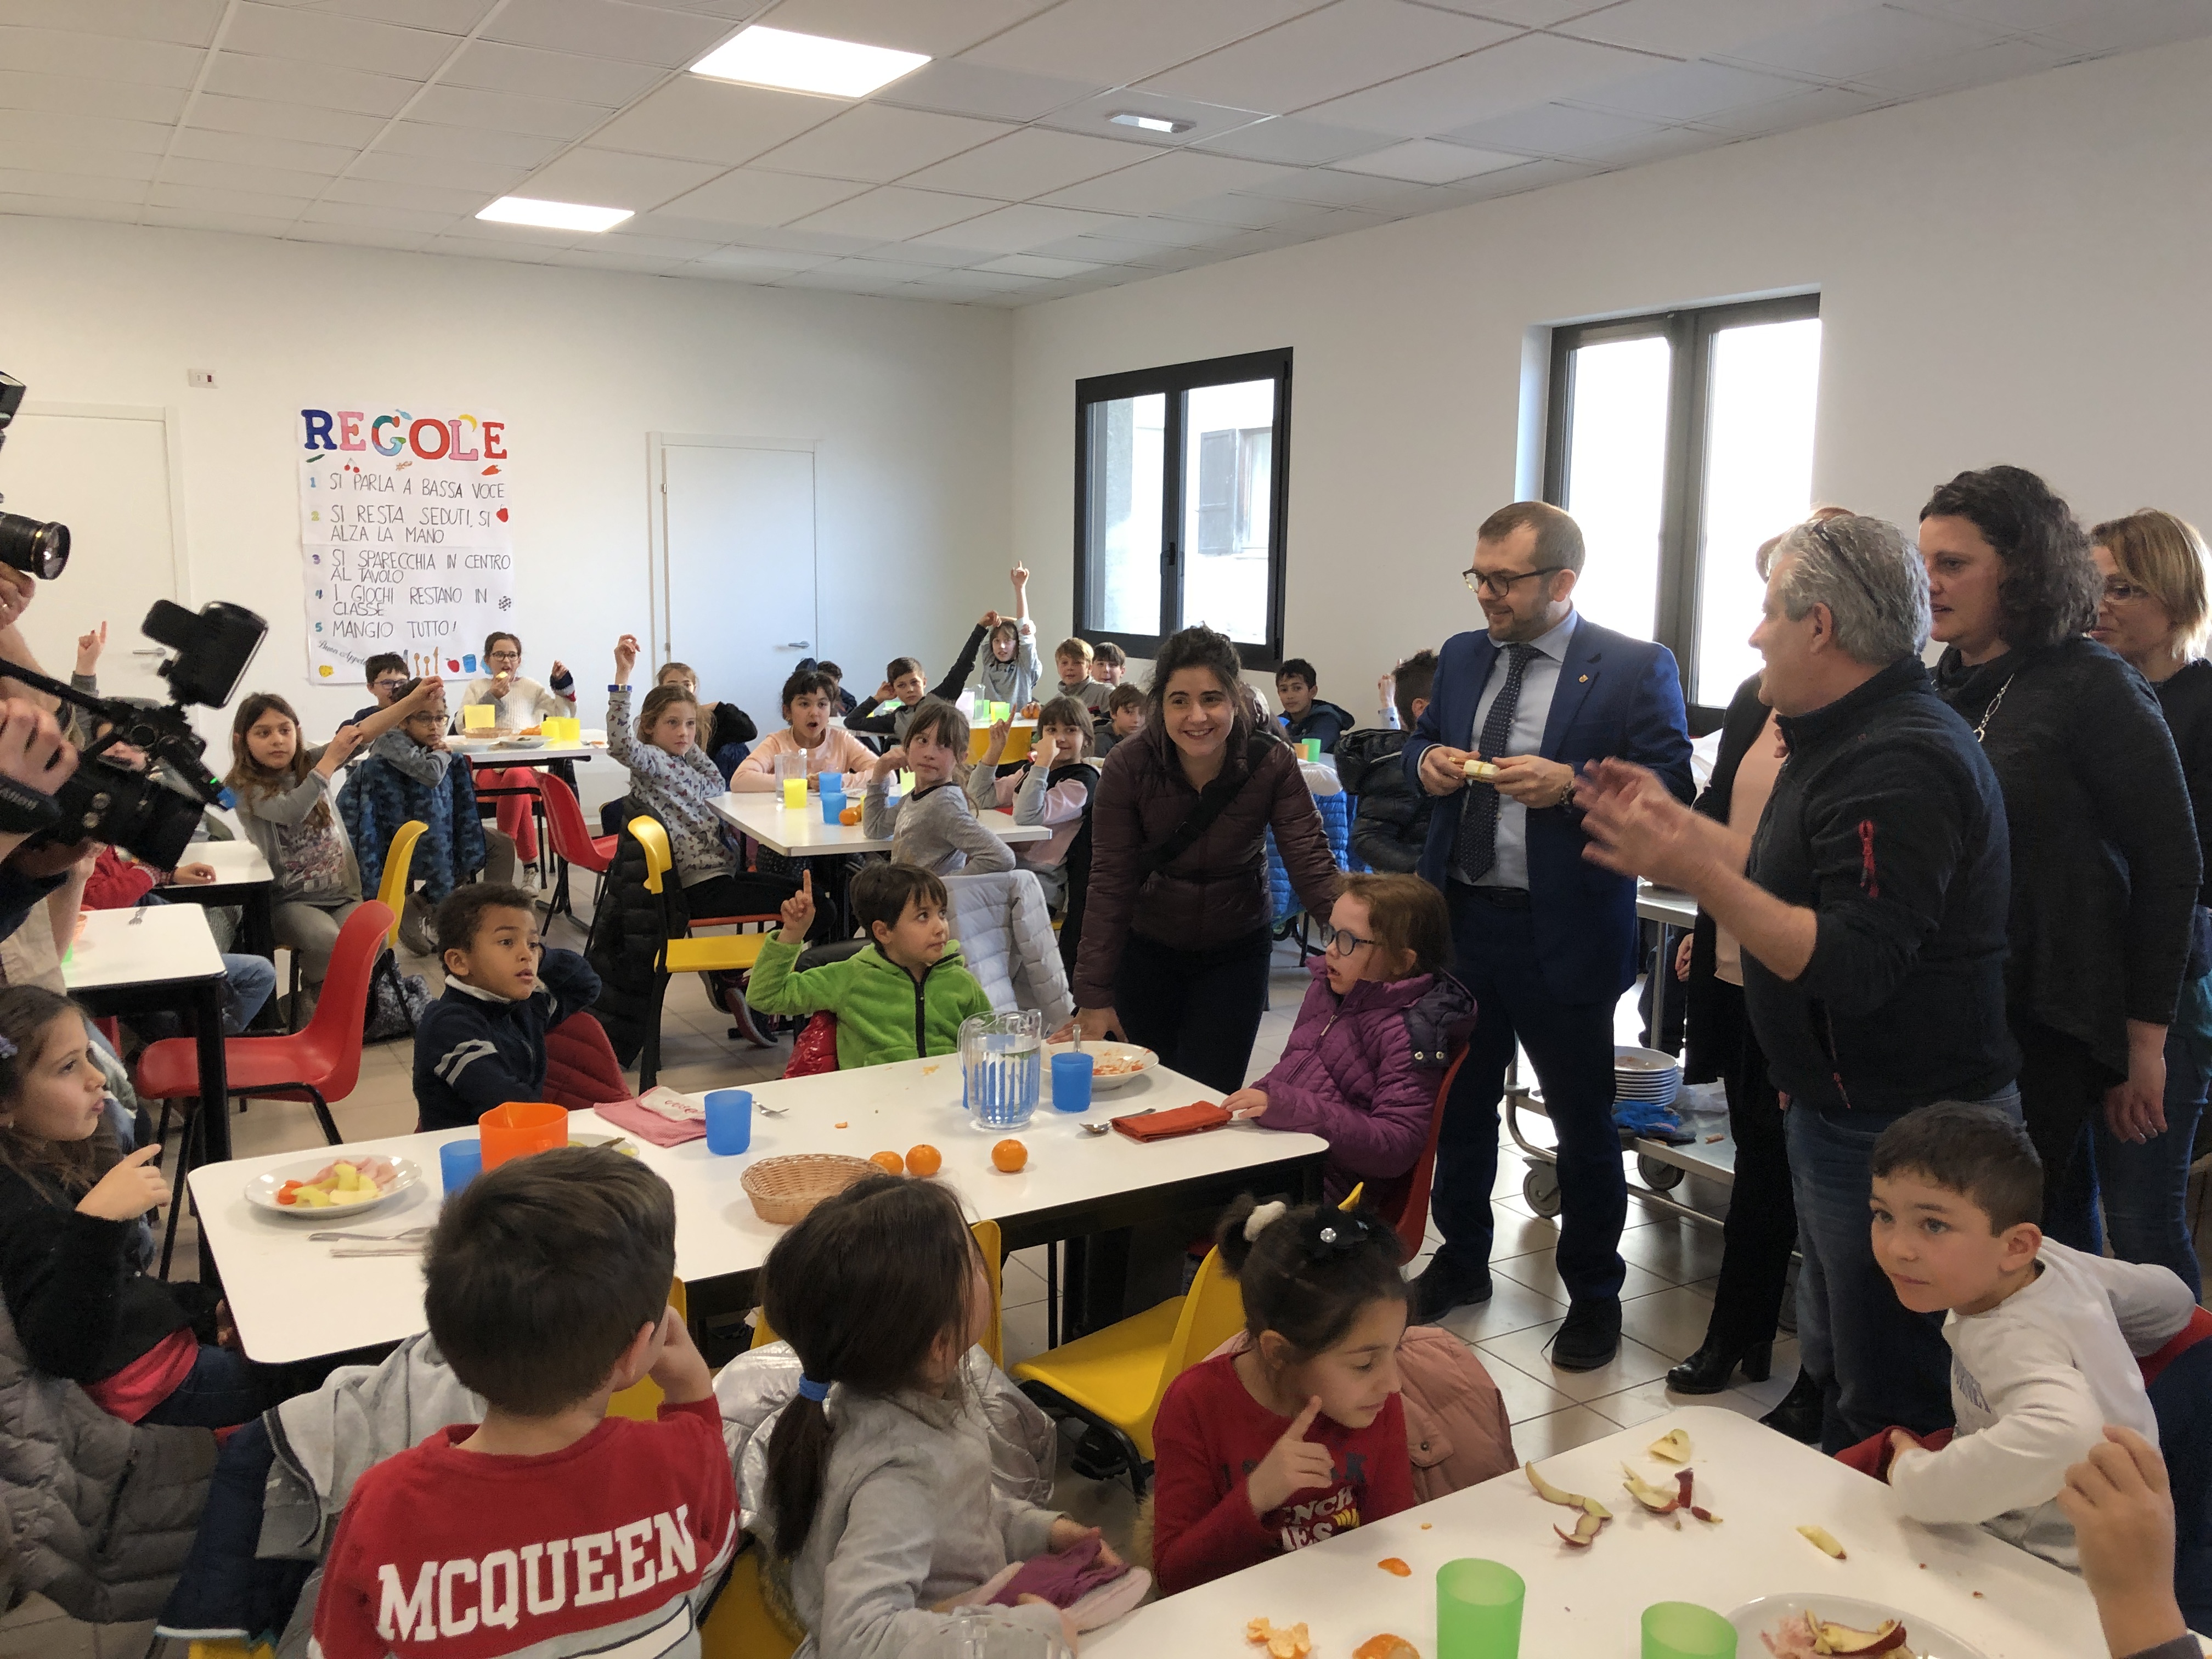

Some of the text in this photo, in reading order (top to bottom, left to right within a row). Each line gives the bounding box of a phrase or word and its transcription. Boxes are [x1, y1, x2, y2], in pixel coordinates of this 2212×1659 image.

[301, 409, 507, 461] REGOLE
[330, 473, 342, 490] SI
[354, 473, 394, 492] PARLA
[403, 478, 411, 495] A
[422, 478, 462, 498] BASSA
[472, 483, 505, 499] VOCE
[311, 511, 320, 521] 2
[330, 504, 344, 523] SI
[357, 505, 404, 524] RESTA
[478, 510, 490, 527] SI
[331, 525, 444, 544] ALZA LA MANO
[312, 549, 511, 570] 3 SI SPARECCHIA IN CENTRO
[330, 567, 404, 584] AL TAVOLO
[351, 585, 394, 604] GIOCHI
[410, 586, 462, 604] RESTANO
[475, 588, 487, 603] IN
[333, 602, 385, 617] CLASSE
[315, 620, 456, 639] 5 MANGIO TUTTO!
[376, 1504, 697, 1642] MCQUEEN
